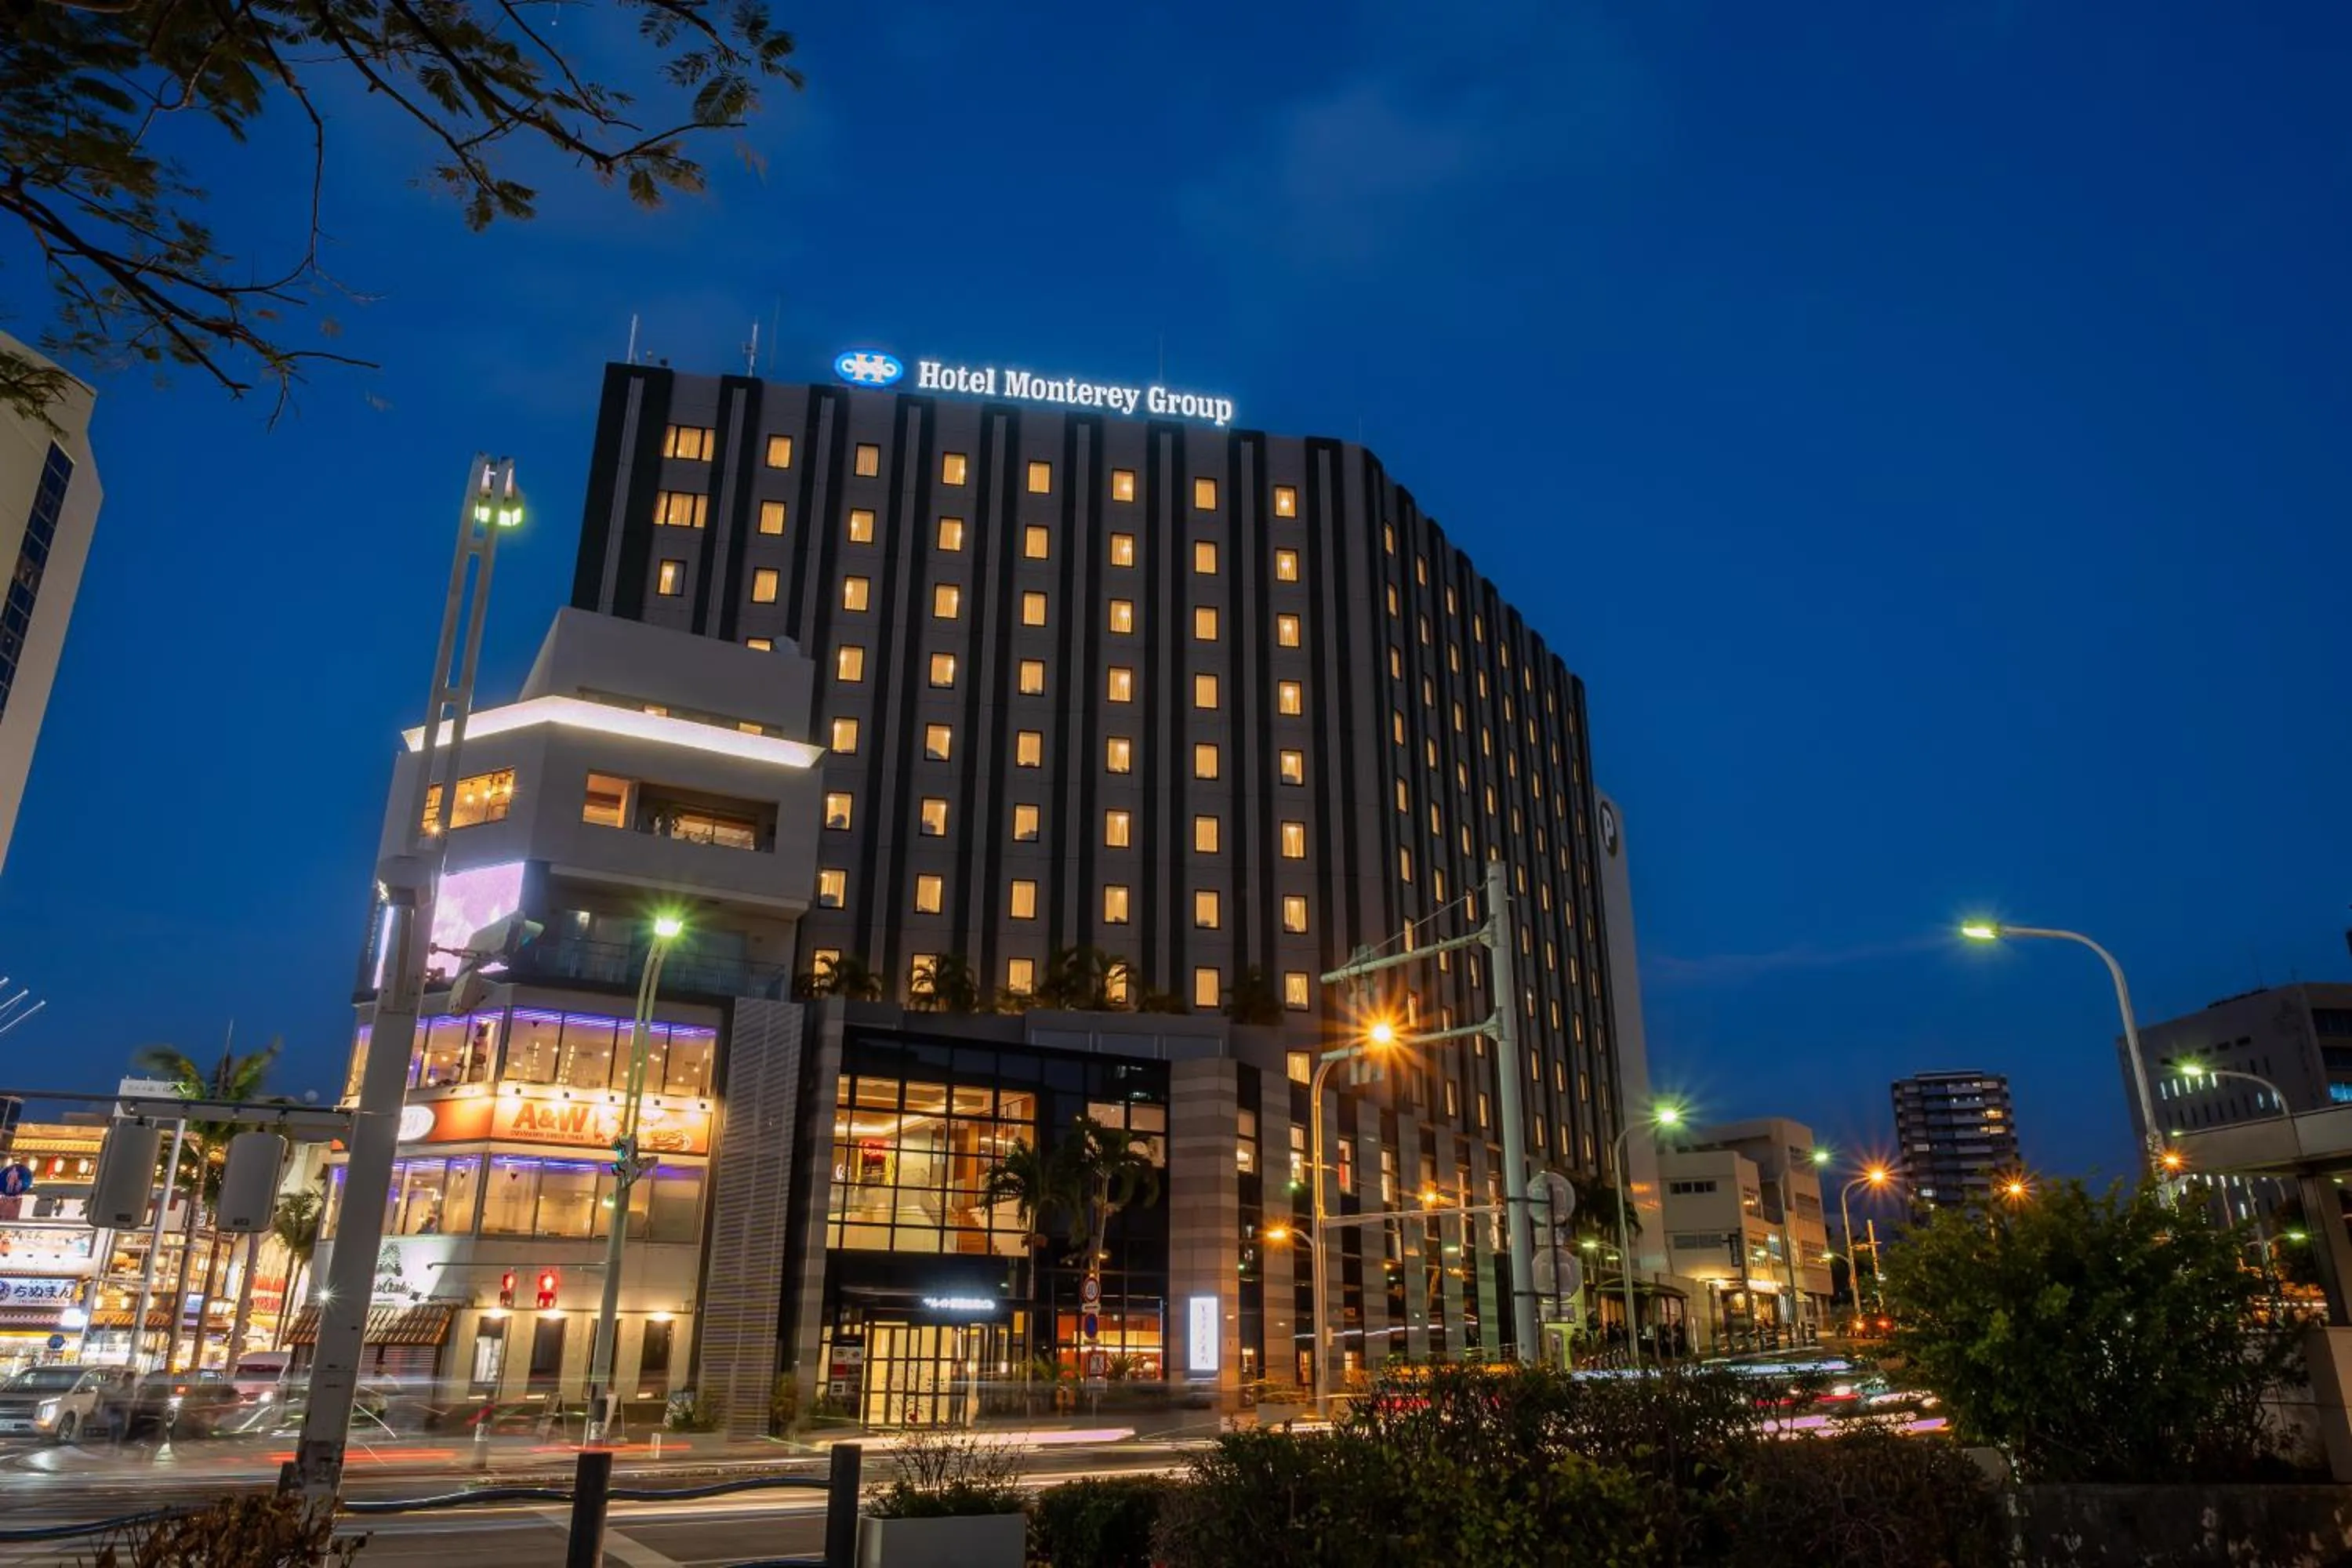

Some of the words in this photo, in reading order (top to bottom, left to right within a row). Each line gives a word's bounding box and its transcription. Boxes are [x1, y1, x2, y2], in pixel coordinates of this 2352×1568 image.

[918, 361, 995, 394] Hotel
[1004, 370, 1141, 415] Monterey
[1148, 386, 1232, 426] Group
[511, 1103, 589, 1133] A&W
[14, 1285, 74, 1299] ちぬまん
